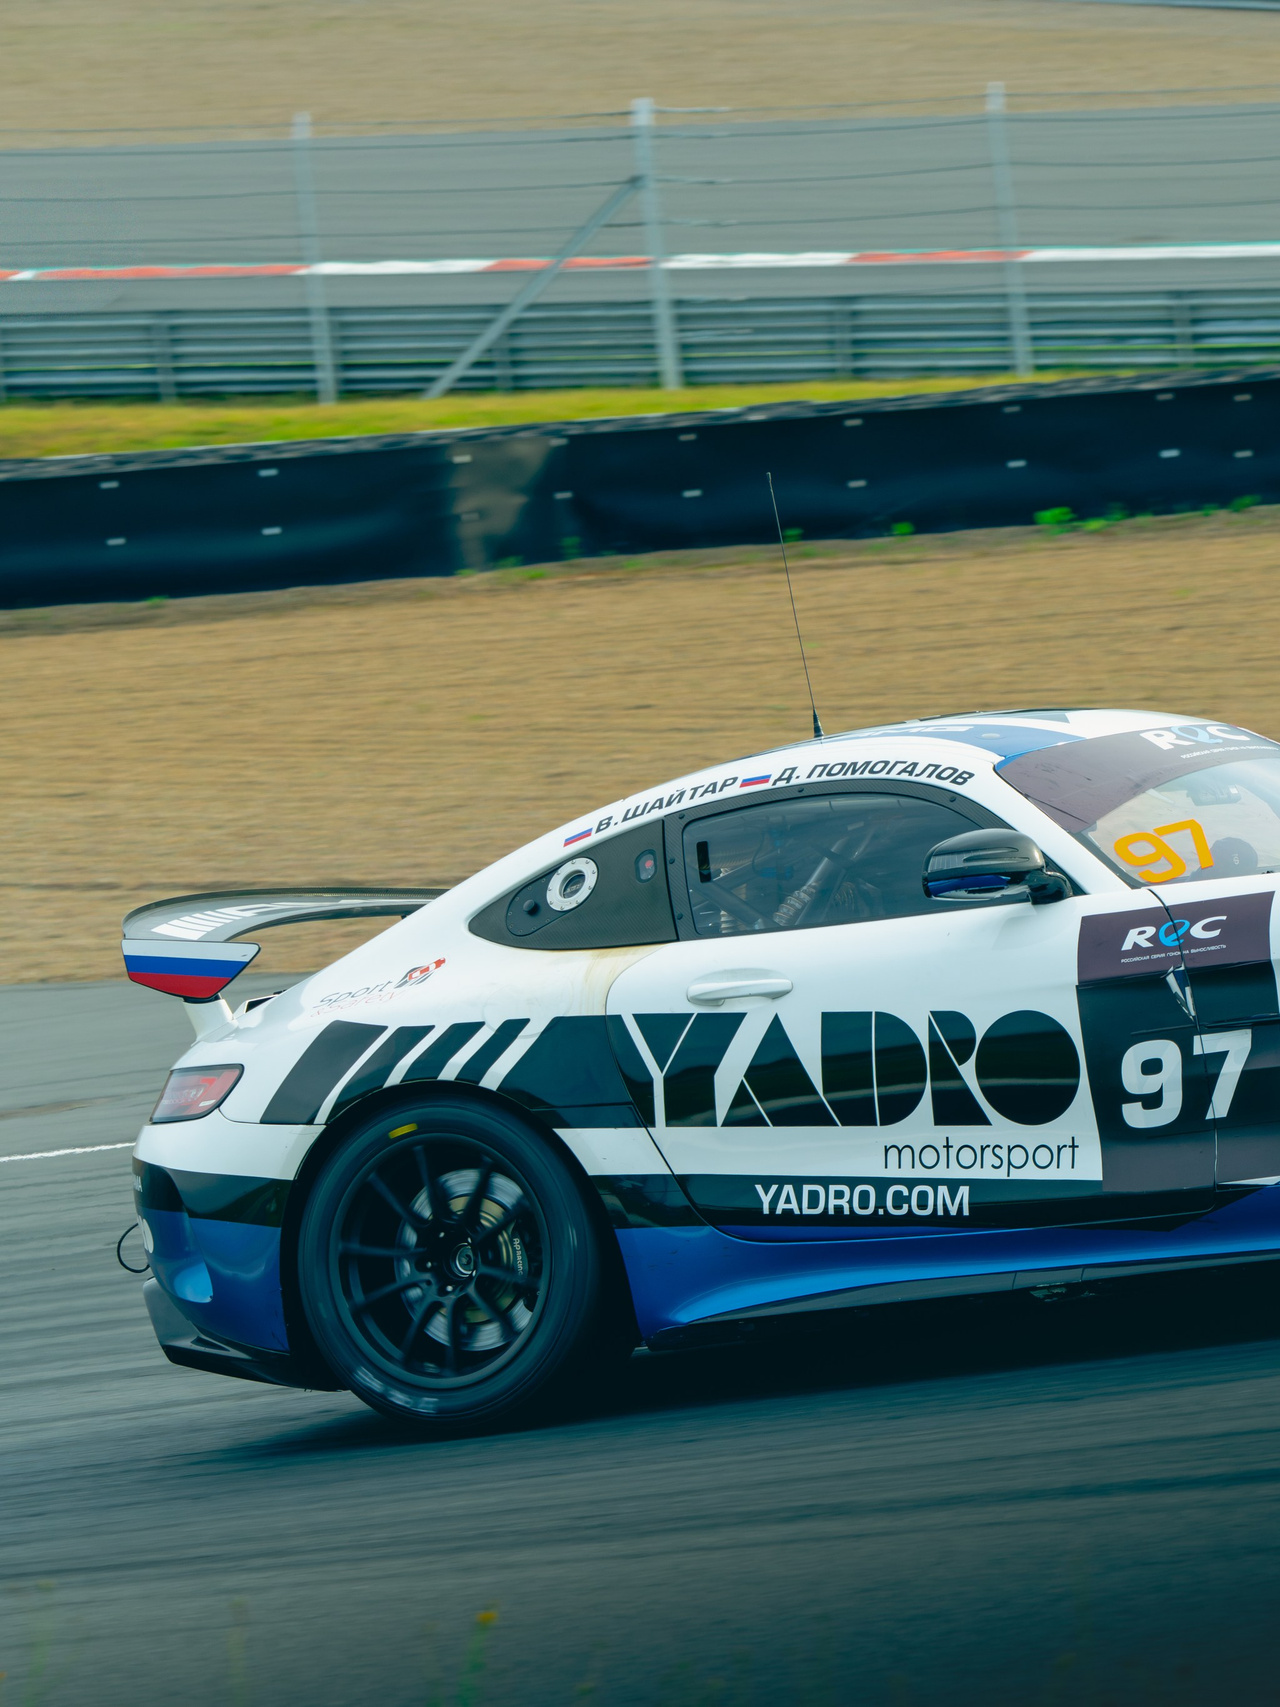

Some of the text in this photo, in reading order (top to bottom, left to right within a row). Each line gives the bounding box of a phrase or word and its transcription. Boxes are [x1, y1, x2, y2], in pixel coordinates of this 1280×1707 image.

[806, 760, 976, 786] ПОМОГАЛОВ
[1113, 818, 1214, 883] 97
[620, 1010, 1080, 1128] YADRO
[1120, 1028, 1253, 1130] 97
[884, 1136, 1080, 1178] motorsport
[755, 1184, 971, 1217] YADRO.COM
